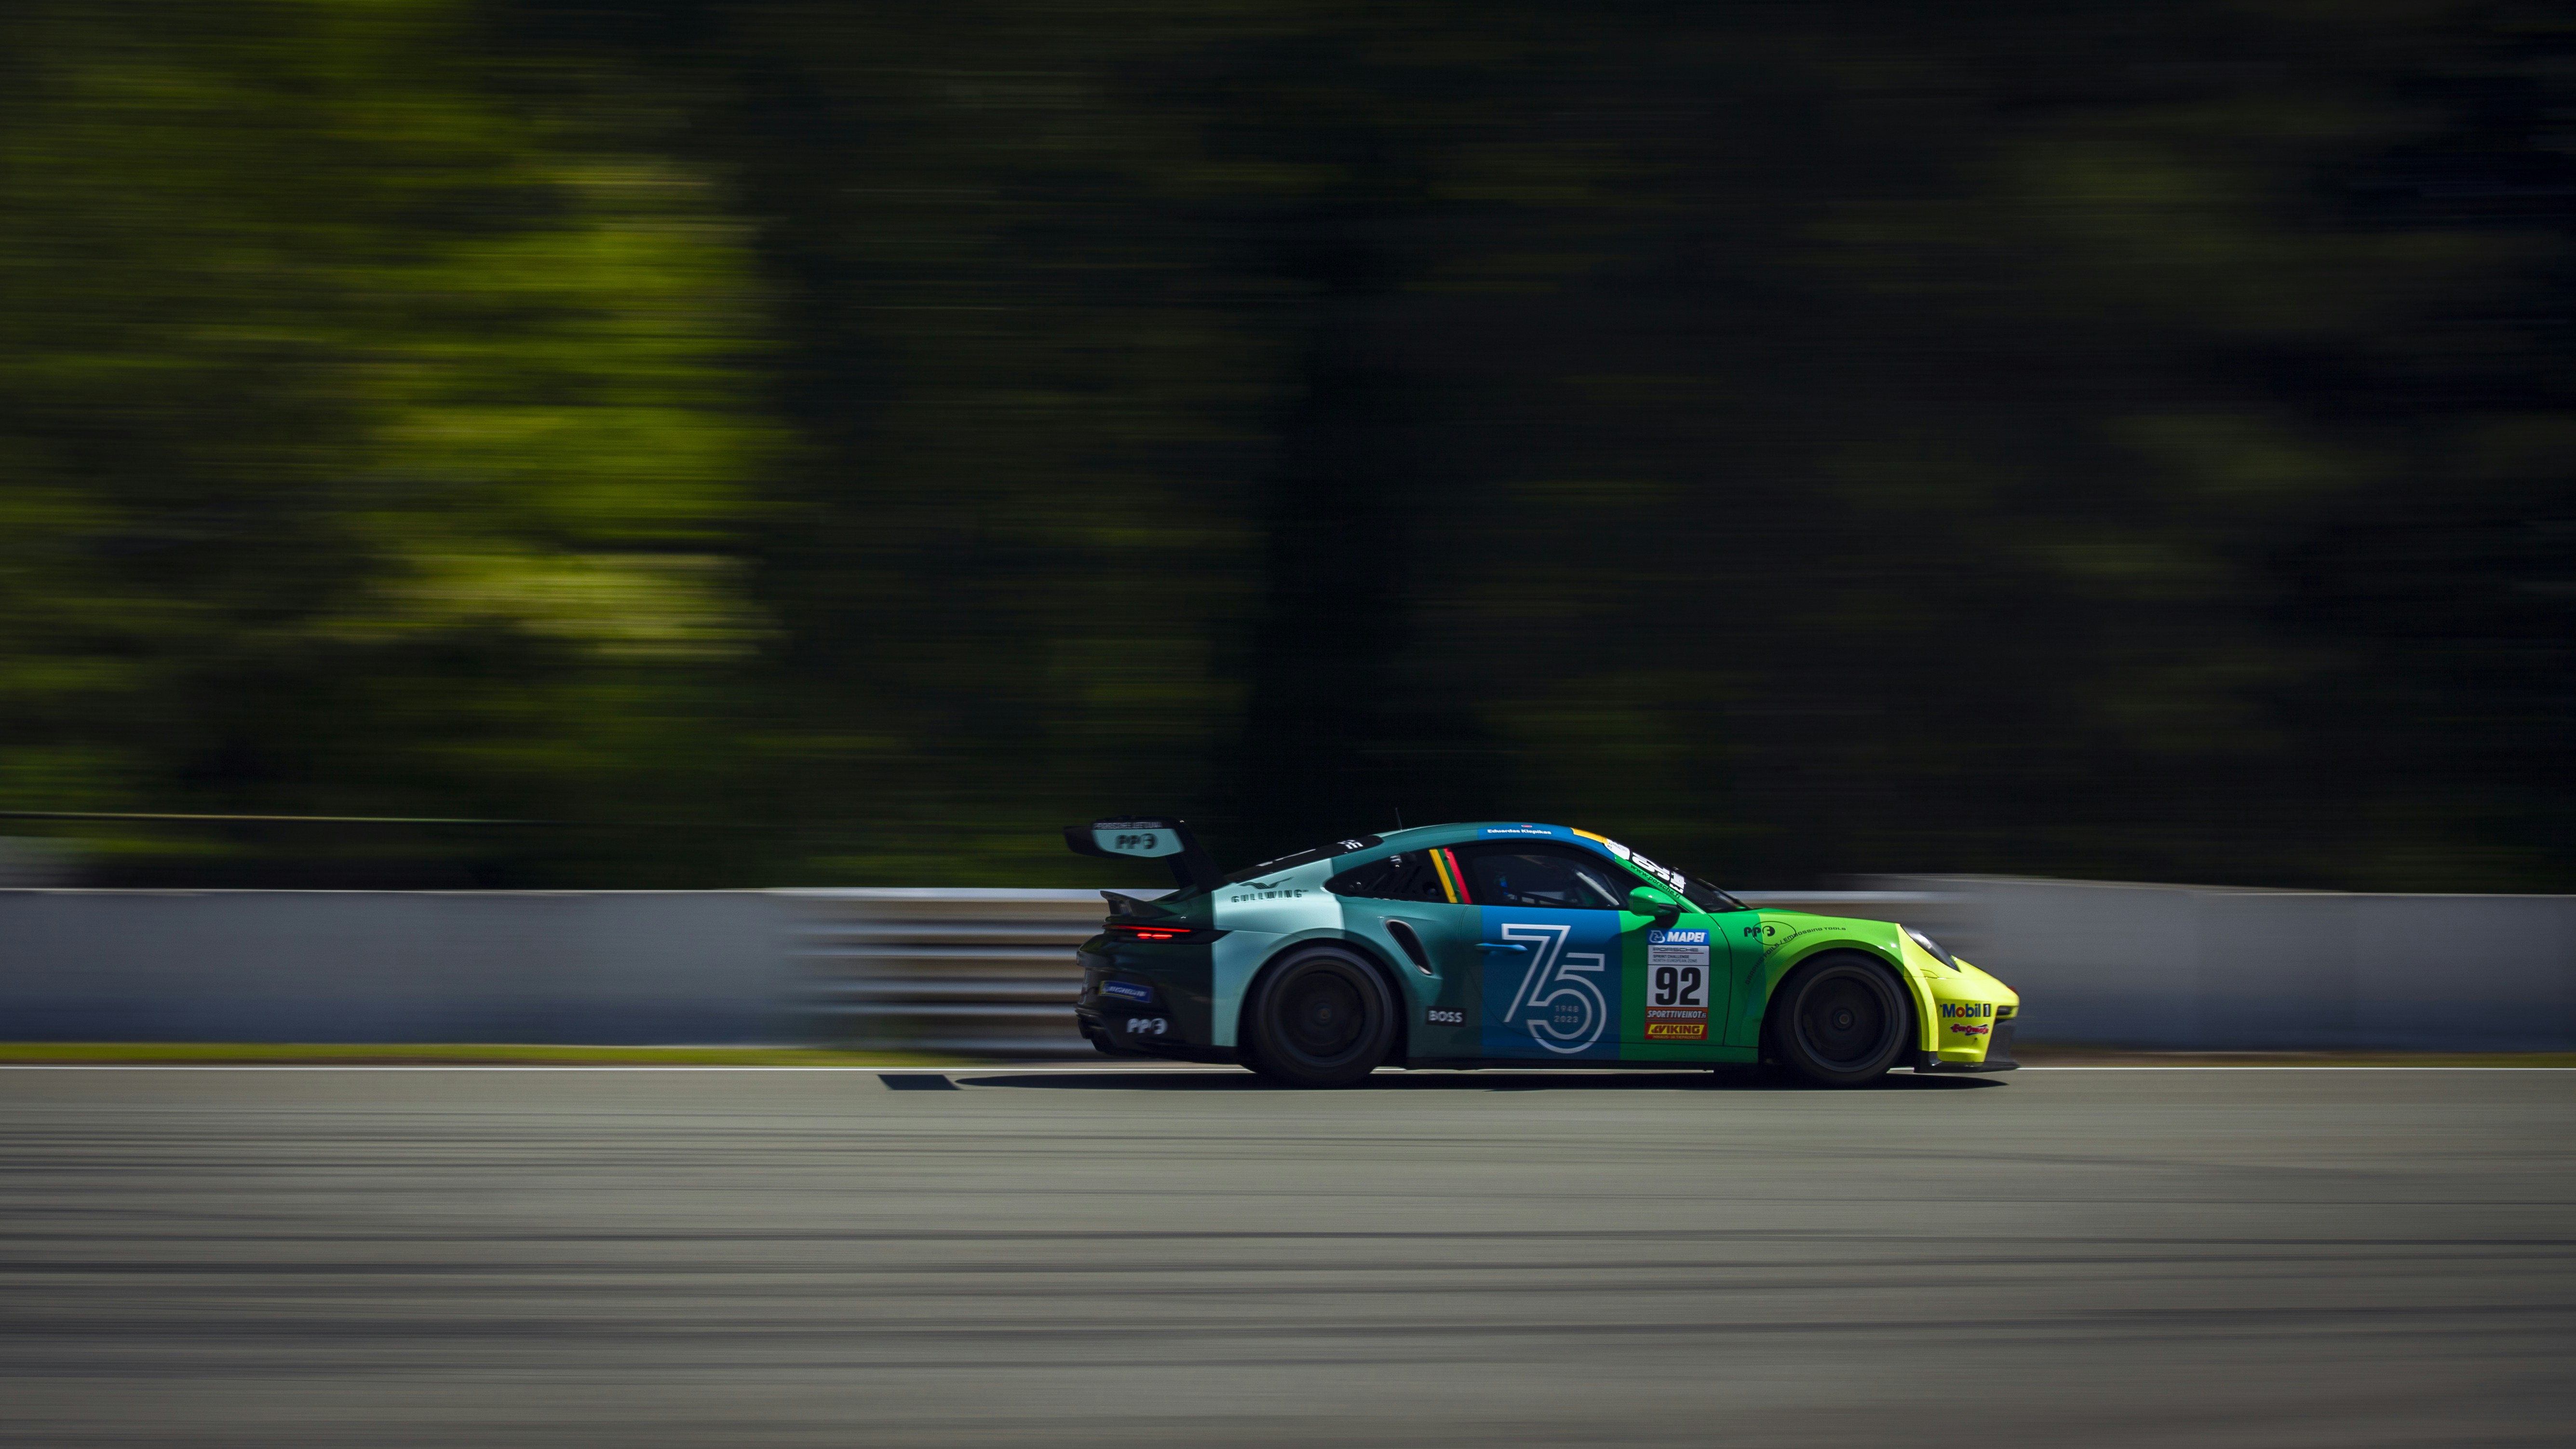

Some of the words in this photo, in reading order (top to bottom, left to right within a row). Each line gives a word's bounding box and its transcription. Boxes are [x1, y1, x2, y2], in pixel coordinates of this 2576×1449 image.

[1631, 865, 1680, 899] www.porsche.fi
[1231, 889, 1302, 903] GULLWING
[1667, 932, 1705, 942] MAPEI
[1745, 957, 1764, 985] GRAPHIC
[1763, 943, 1780, 958] FOILS
[1783, 928, 1822, 942] EMBOSSING
[1655, 967, 1701, 1005] 92
[1429, 1010, 1463, 1022] BOSS
[1647, 1010, 1706, 1018] SPORTTIVEIKOT.fi
[1942, 1003, 1981, 1017] Mobil
[1984, 1004, 1990, 1016] 1
[1658, 1025, 1700, 1034] VIKING
